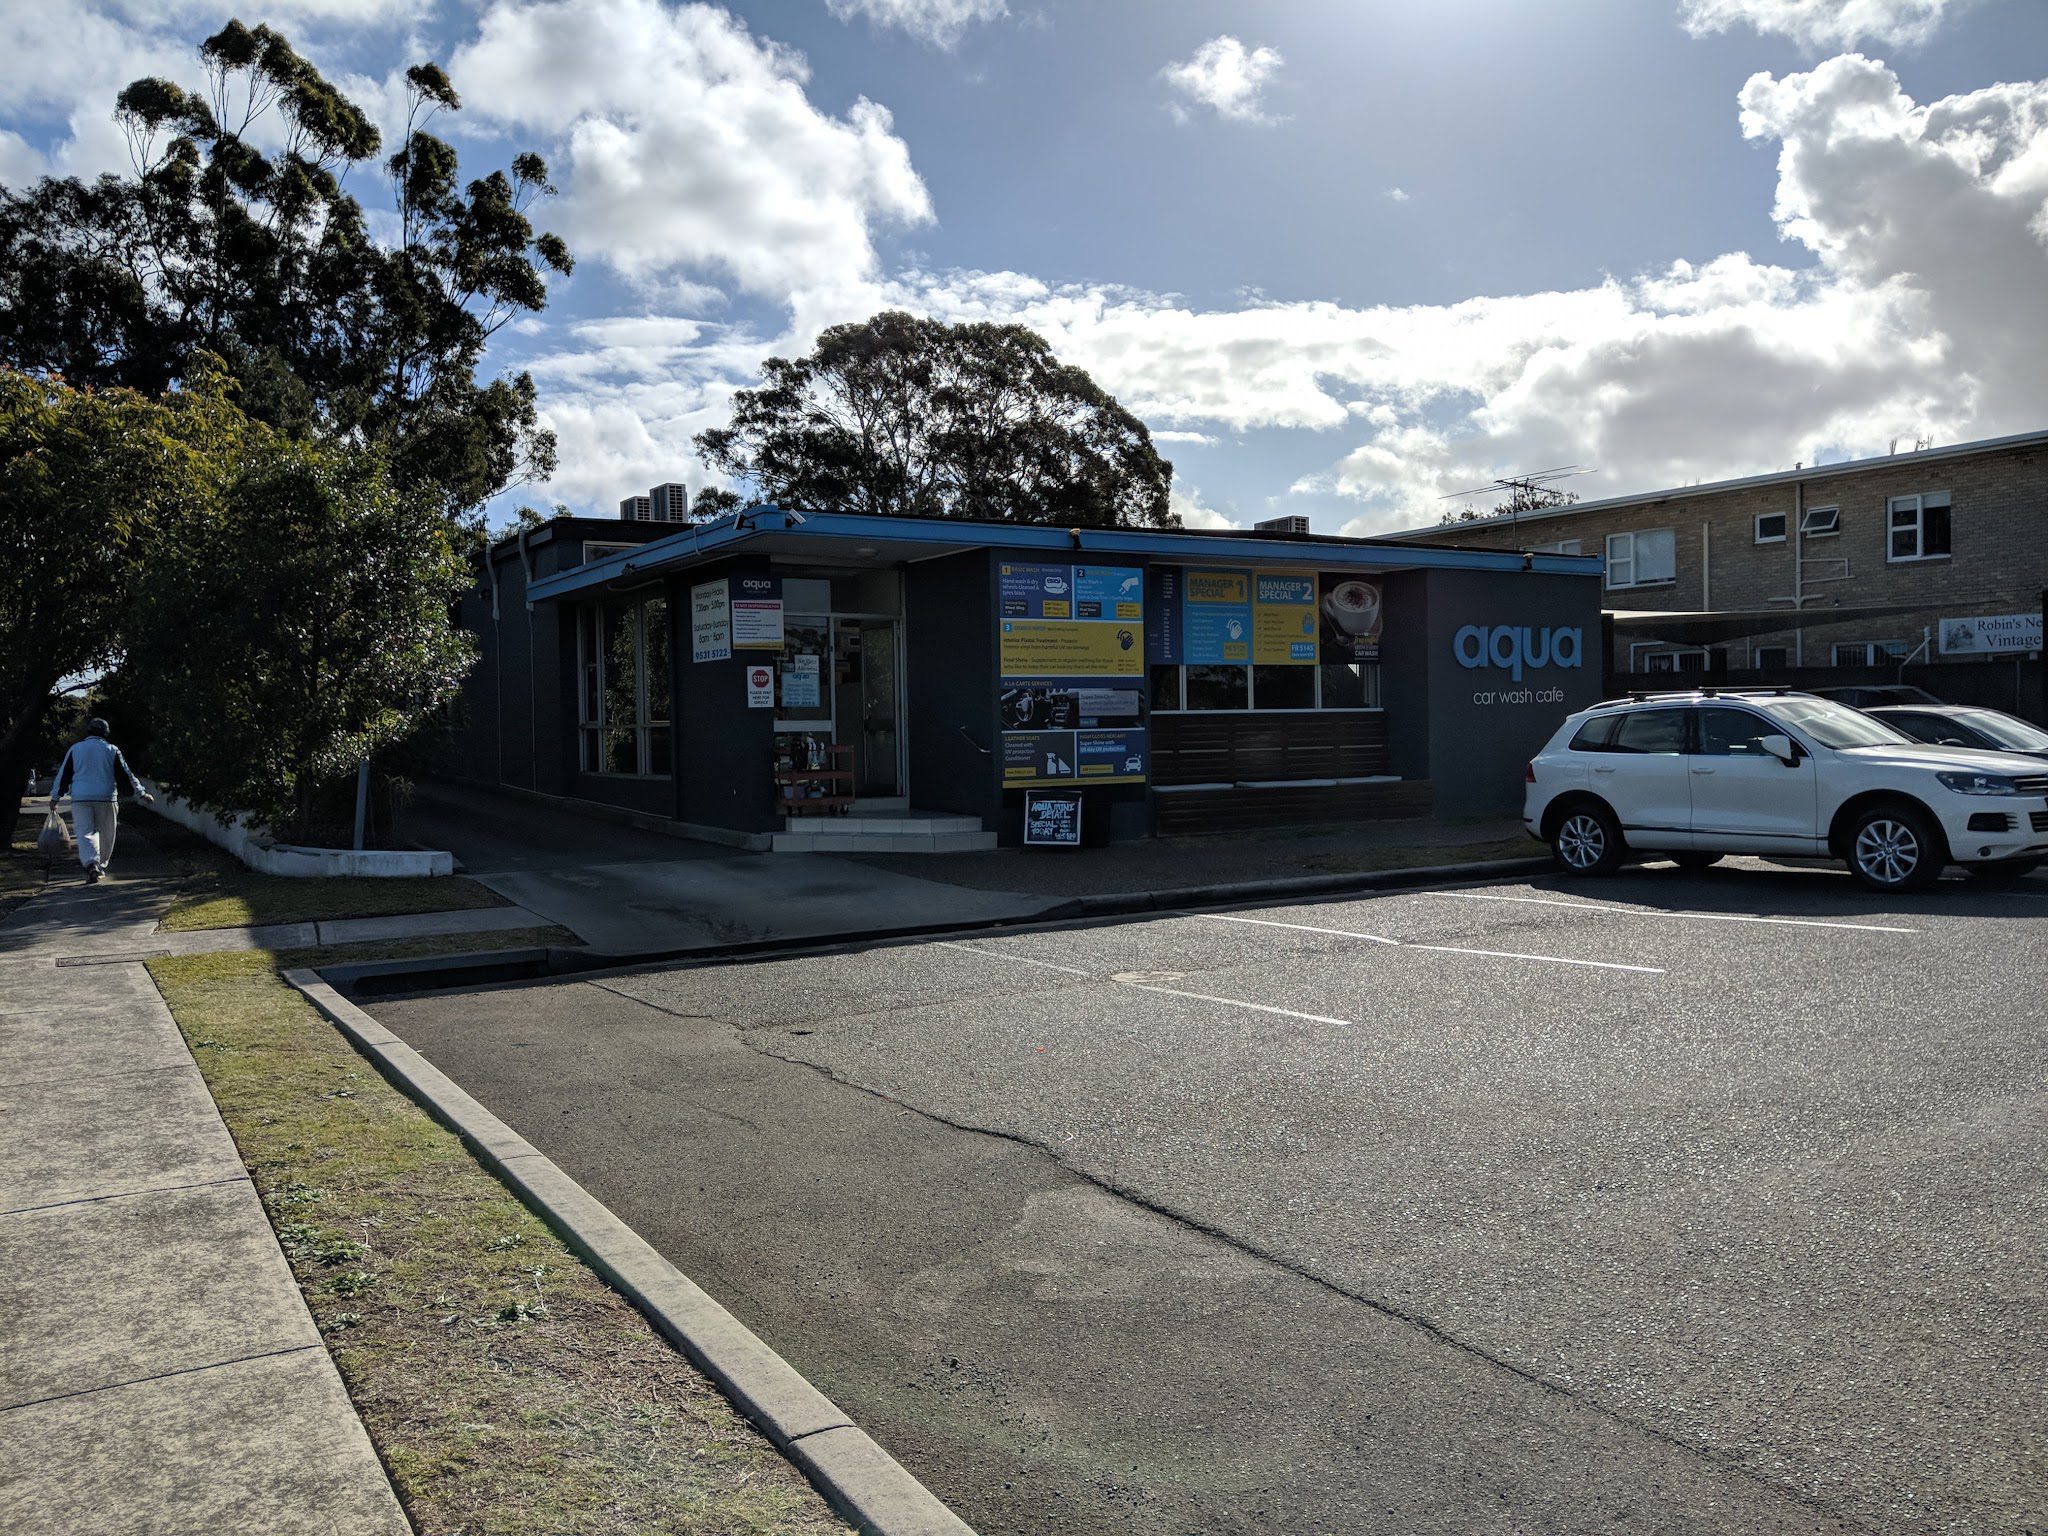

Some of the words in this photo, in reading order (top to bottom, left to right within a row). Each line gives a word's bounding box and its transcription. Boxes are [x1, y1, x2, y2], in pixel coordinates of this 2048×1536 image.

[742, 579, 771, 590] aqua
[1190, 578, 1233, 588] MANAGER
[1259, 581, 1300, 591] MANAGER
[1302, 583, 1313, 600] 2
[1259, 590, 1293, 600] SPECIAL
[1978, 618, 2021, 631] Robin's
[1986, 634, 2042, 648] Vintage
[695, 650, 710, 660] 9531
[711, 648, 728, 658] 5122
[1453, 624, 1582, 682] aqua
[753, 675, 769, 683] STOP
[1473, 691, 1496, 705] car
[1499, 688, 1533, 704] wash
[1535, 686, 1565, 703] cafe
